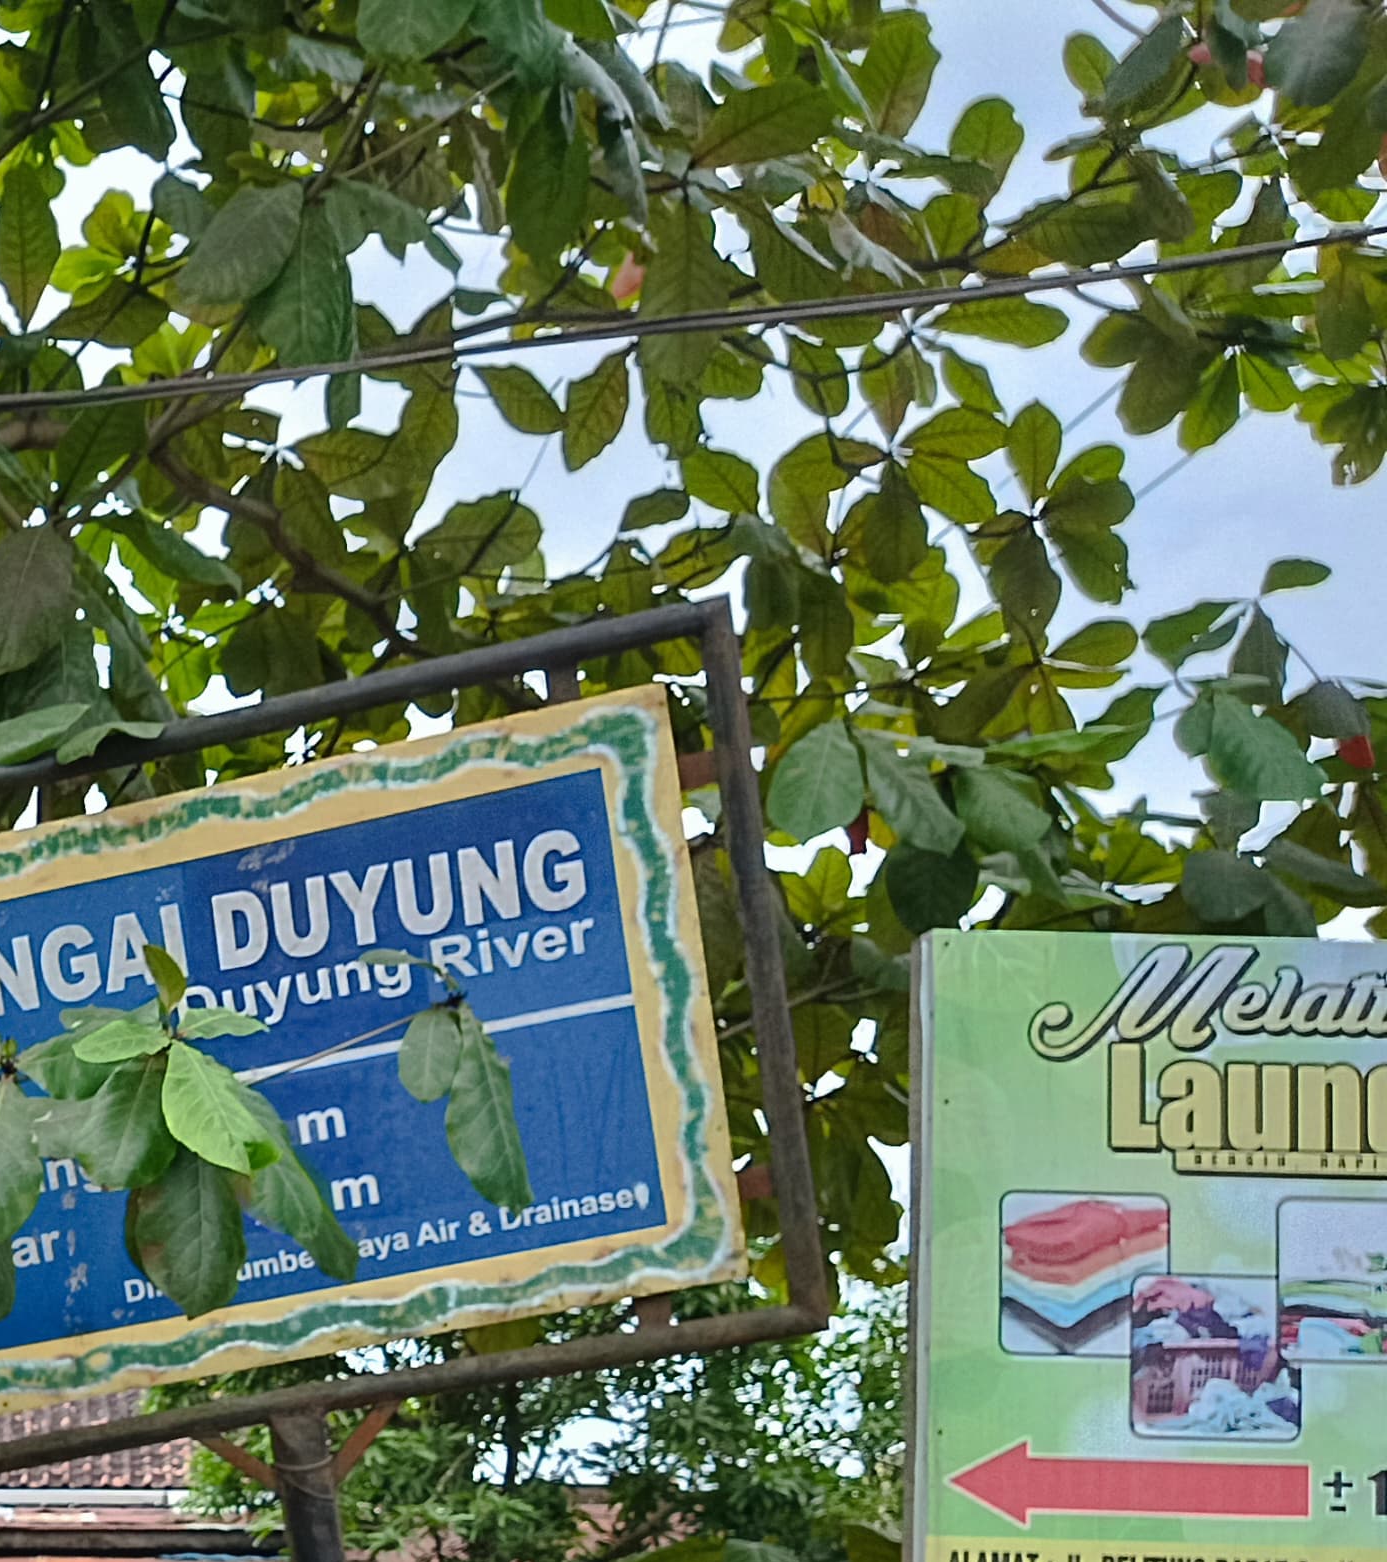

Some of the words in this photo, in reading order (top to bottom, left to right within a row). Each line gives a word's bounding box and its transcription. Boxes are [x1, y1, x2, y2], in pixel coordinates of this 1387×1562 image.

[211, 829, 587, 971] DUYUNG
[430, 918, 594, 983] River
[297, 1106, 347, 1145] m
[331, 1174, 380, 1211] m
[236, 1249, 316, 1282] umbe
[357, 1231, 409, 1260] aya
[417, 1217, 461, 1247] Air
[468, 1211, 492, 1237] &
[499, 1187, 634, 1232] Drainase
